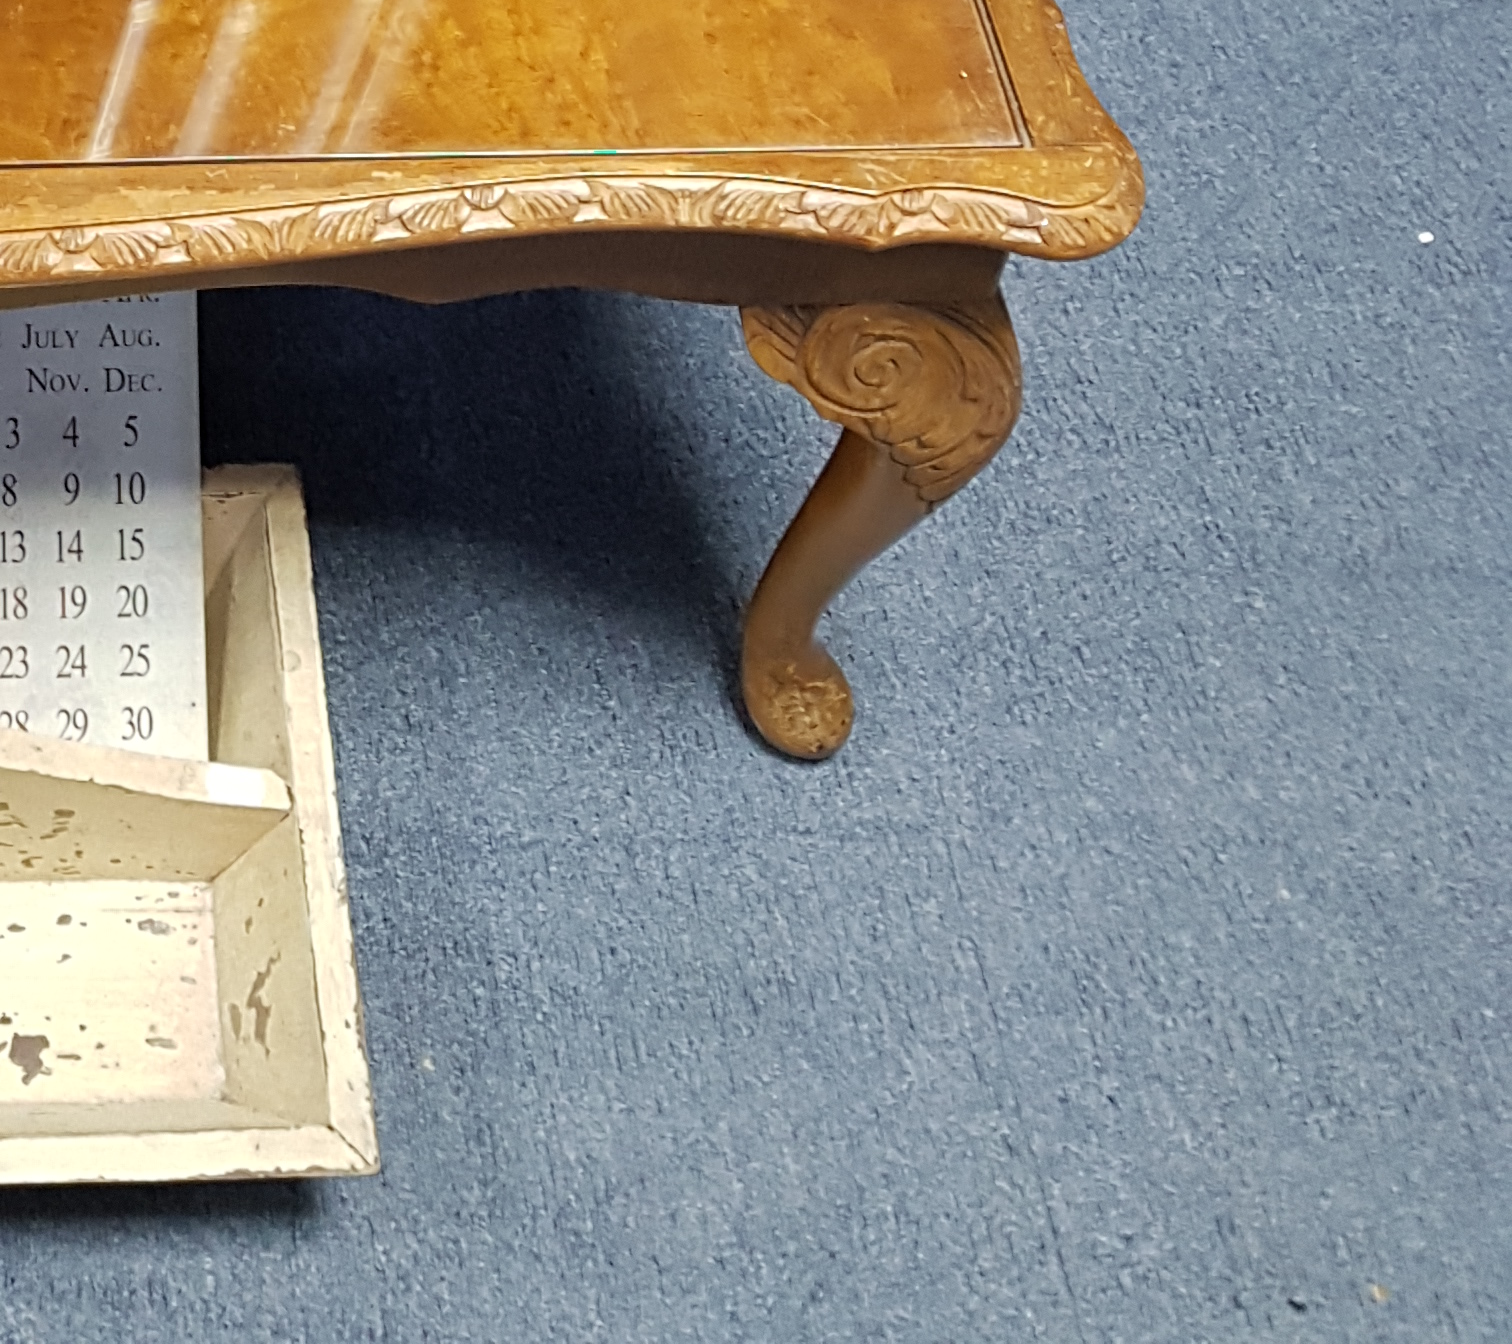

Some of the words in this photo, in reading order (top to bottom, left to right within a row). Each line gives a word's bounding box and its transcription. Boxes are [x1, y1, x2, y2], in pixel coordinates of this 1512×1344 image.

[21, 323, 80, 349] JULY
[98, 323, 160, 348] AUG.
[25, 367, 89, 393] NOV.
[104, 367, 163, 393] DEC.
[5, 417, 20, 450] 3
[62, 415, 80, 448] 4
[123, 415, 138, 447] 5
[1, 473, 18, 507] 8
[63, 472, 80, 503] 9
[114, 471, 146, 505] 10
[0, 529, 26, 563] 13
[56, 529, 84, 563] 14
[118, 528, 144, 561] 15
[1, 587, 28, 620] 18
[59, 585, 87, 619] 19
[117, 584, 149, 618] 20
[0, 645, 29, 679] 23
[56, 644, 87, 679] 24
[120, 643, 150, 677] 25
[56, 708, 89, 743] 29
[121, 706, 154, 742] 30
